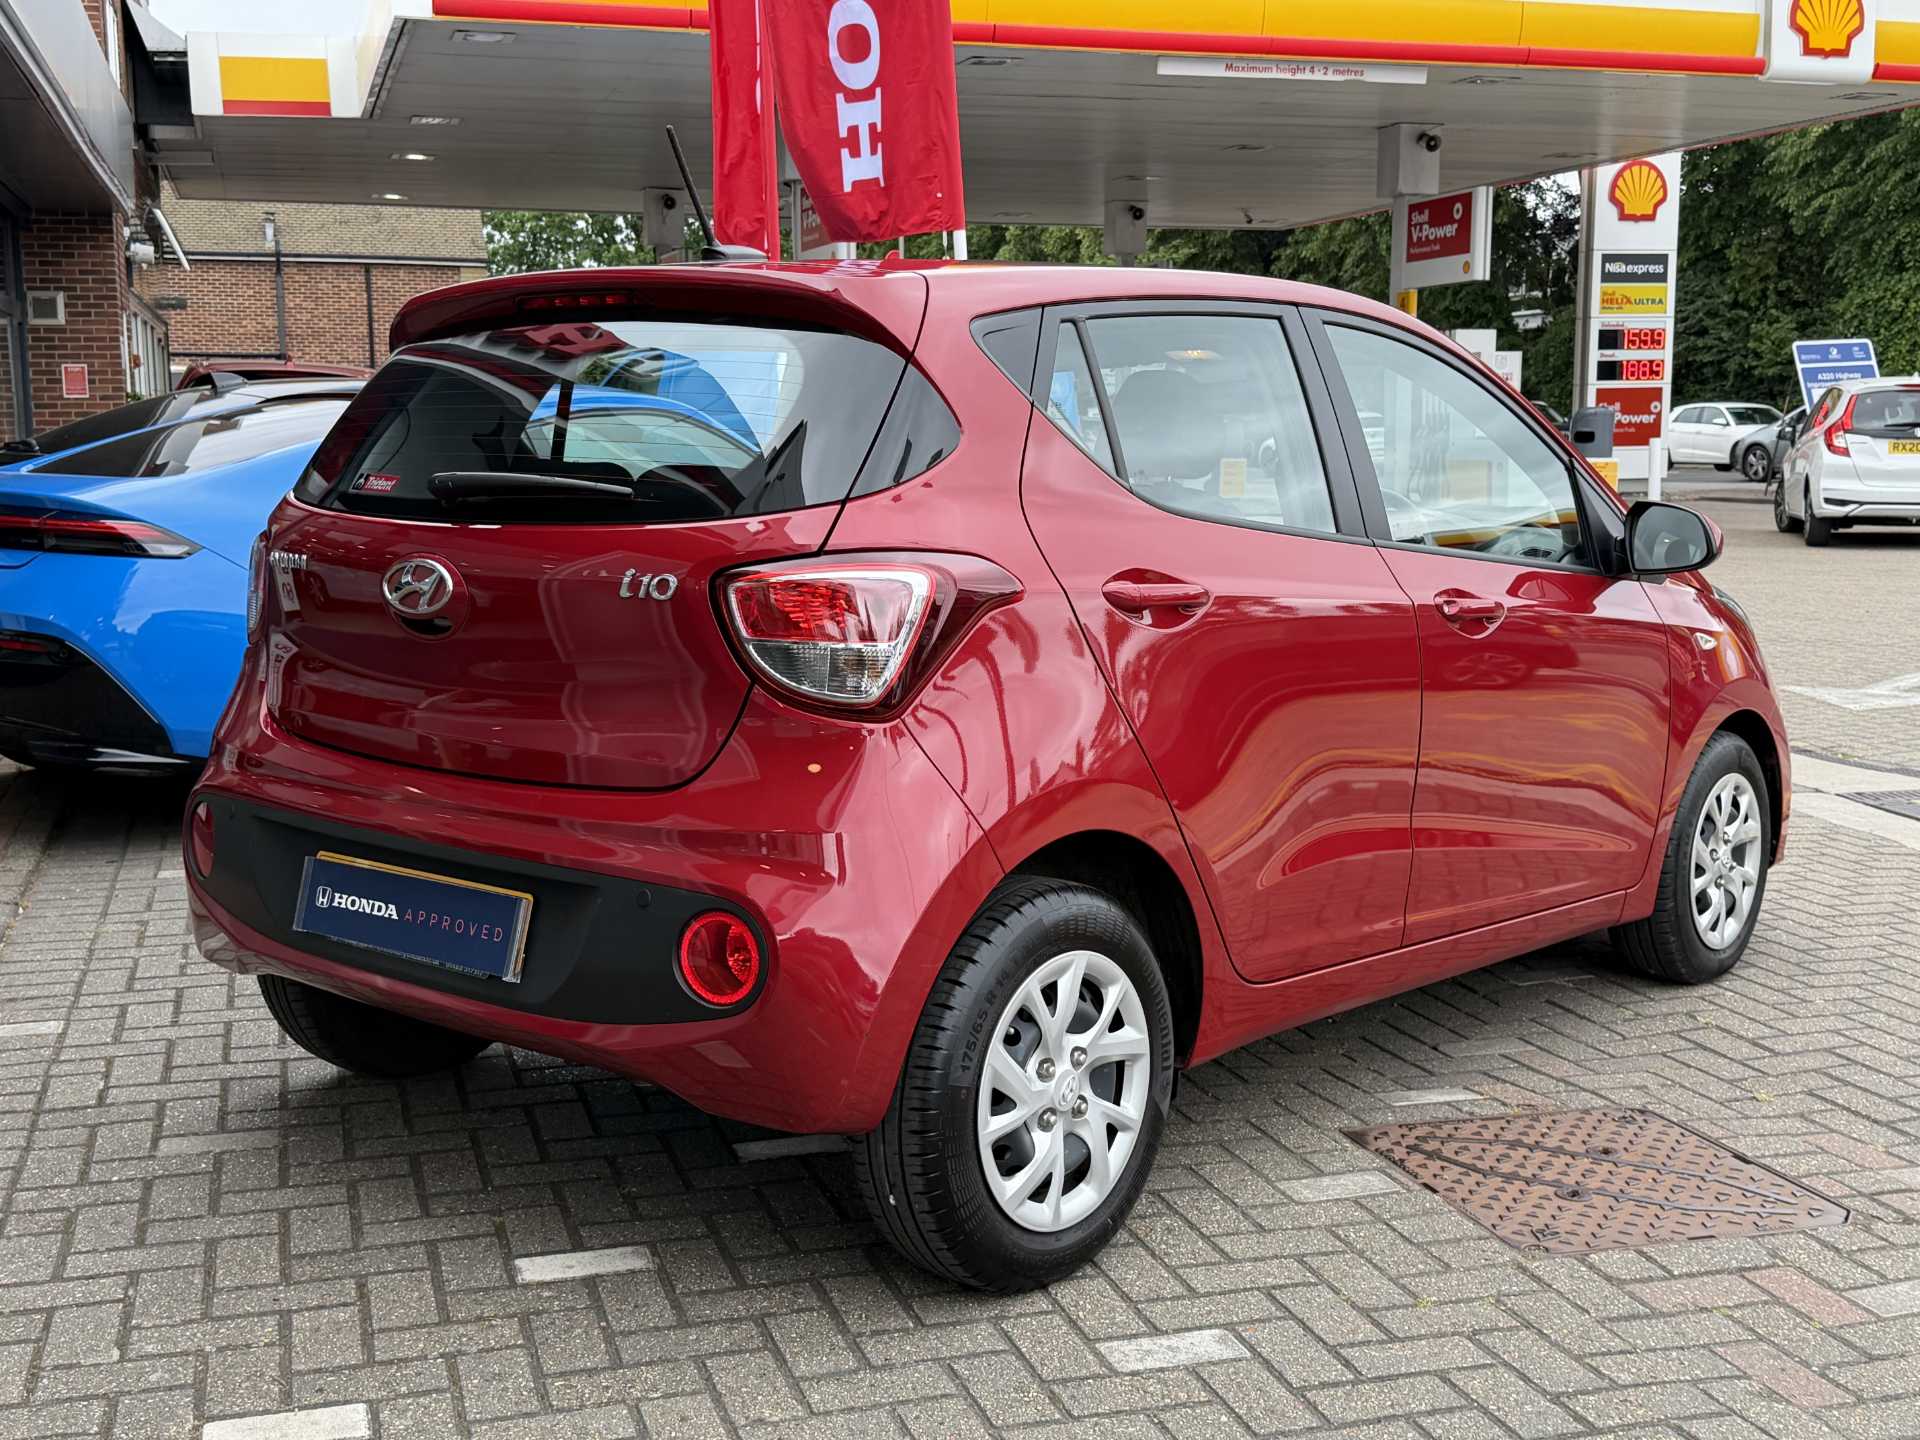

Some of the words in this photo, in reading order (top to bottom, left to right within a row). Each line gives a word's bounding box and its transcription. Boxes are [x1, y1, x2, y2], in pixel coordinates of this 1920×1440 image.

[1224, 63, 1273, 74] Maximum
[1275, 64, 1306, 76] height
[1332, 67, 1365, 77] metres
[1411, 208, 1430, 225] Shell
[1626, 264, 1664, 275] express
[1634, 298, 1664, 306] ULTRA
[1623, 329, 1665, 350] 159.9
[1613, 412, 1656, 424] Power
[332, 892, 399, 920] HONDA
[404, 909, 503, 942] APPROVED
